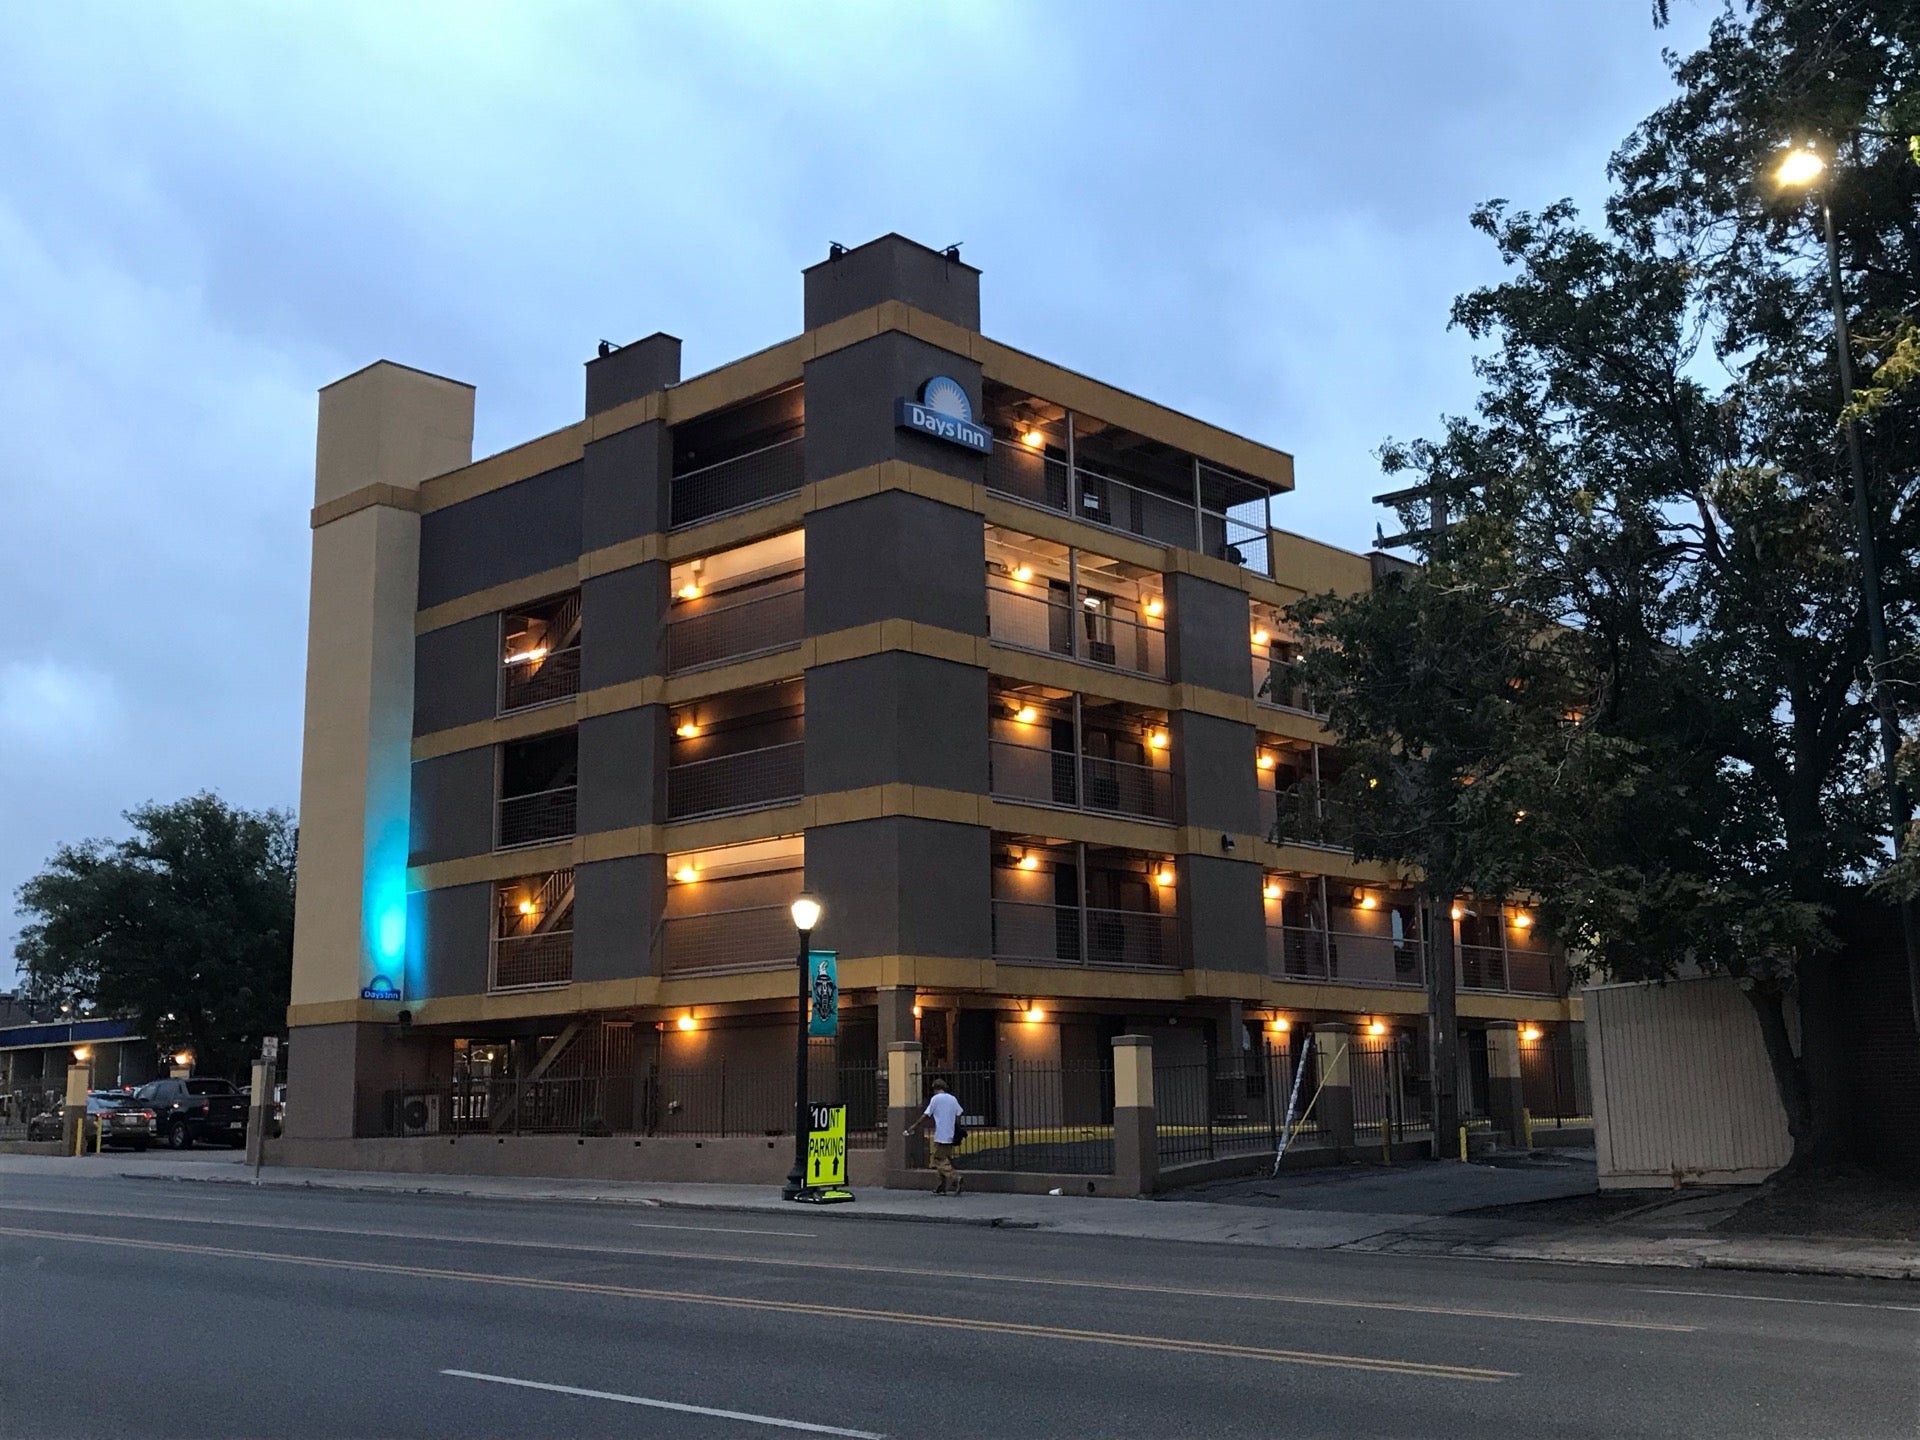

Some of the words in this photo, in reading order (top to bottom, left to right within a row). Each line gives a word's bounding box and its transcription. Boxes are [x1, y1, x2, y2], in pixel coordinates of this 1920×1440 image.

[913, 407, 955, 436] Days
[957, 423, 985, 447] Inn
[364, 991, 384, 999] Days
[385, 991, 399, 999] Inn
[808, 1136, 844, 1157] PARKING
